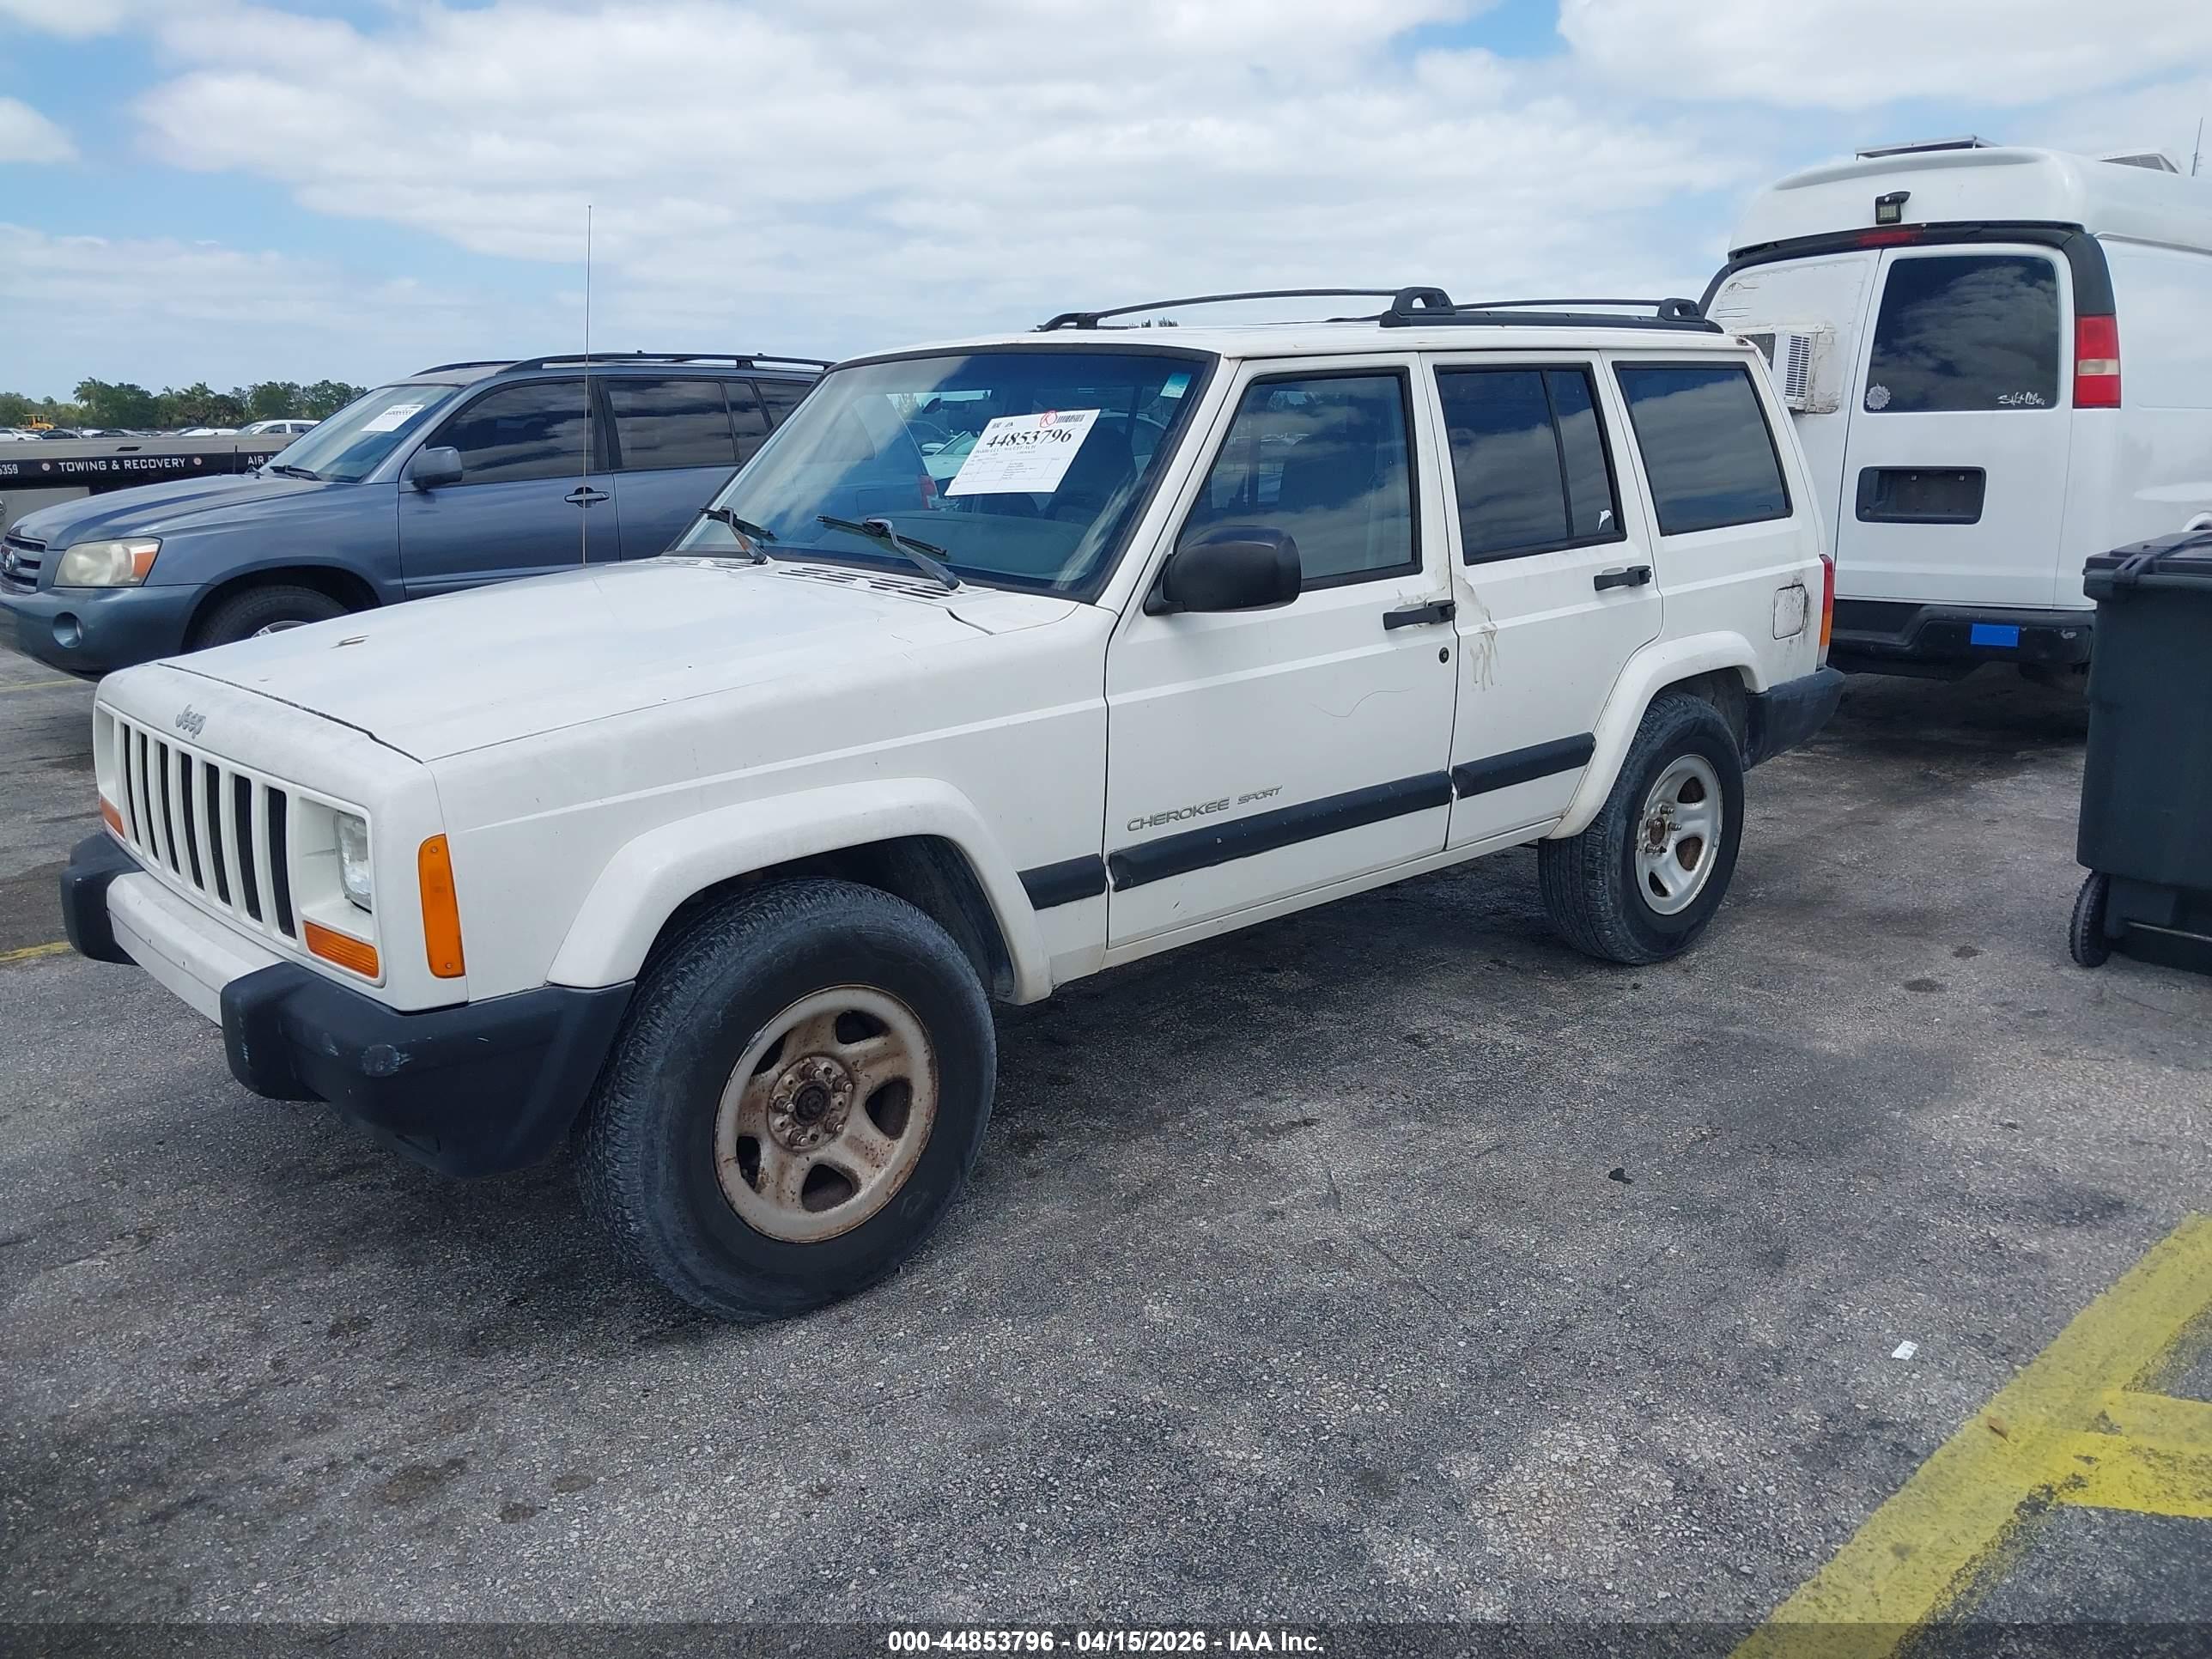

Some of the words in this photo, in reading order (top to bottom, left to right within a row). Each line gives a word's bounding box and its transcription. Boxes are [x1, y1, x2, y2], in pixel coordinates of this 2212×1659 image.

[987, 428, 1076, 447] 44853796
[58, 460, 106, 472] TOWING
[112, 460, 120, 470] &
[124, 458, 185, 470] RECOVERY
[247, 455, 264, 465] AIR
[175, 704, 206, 739] Jeep
[1127, 797, 1230, 831] CHEROKEE
[1237, 785, 1283, 805] SPORT
